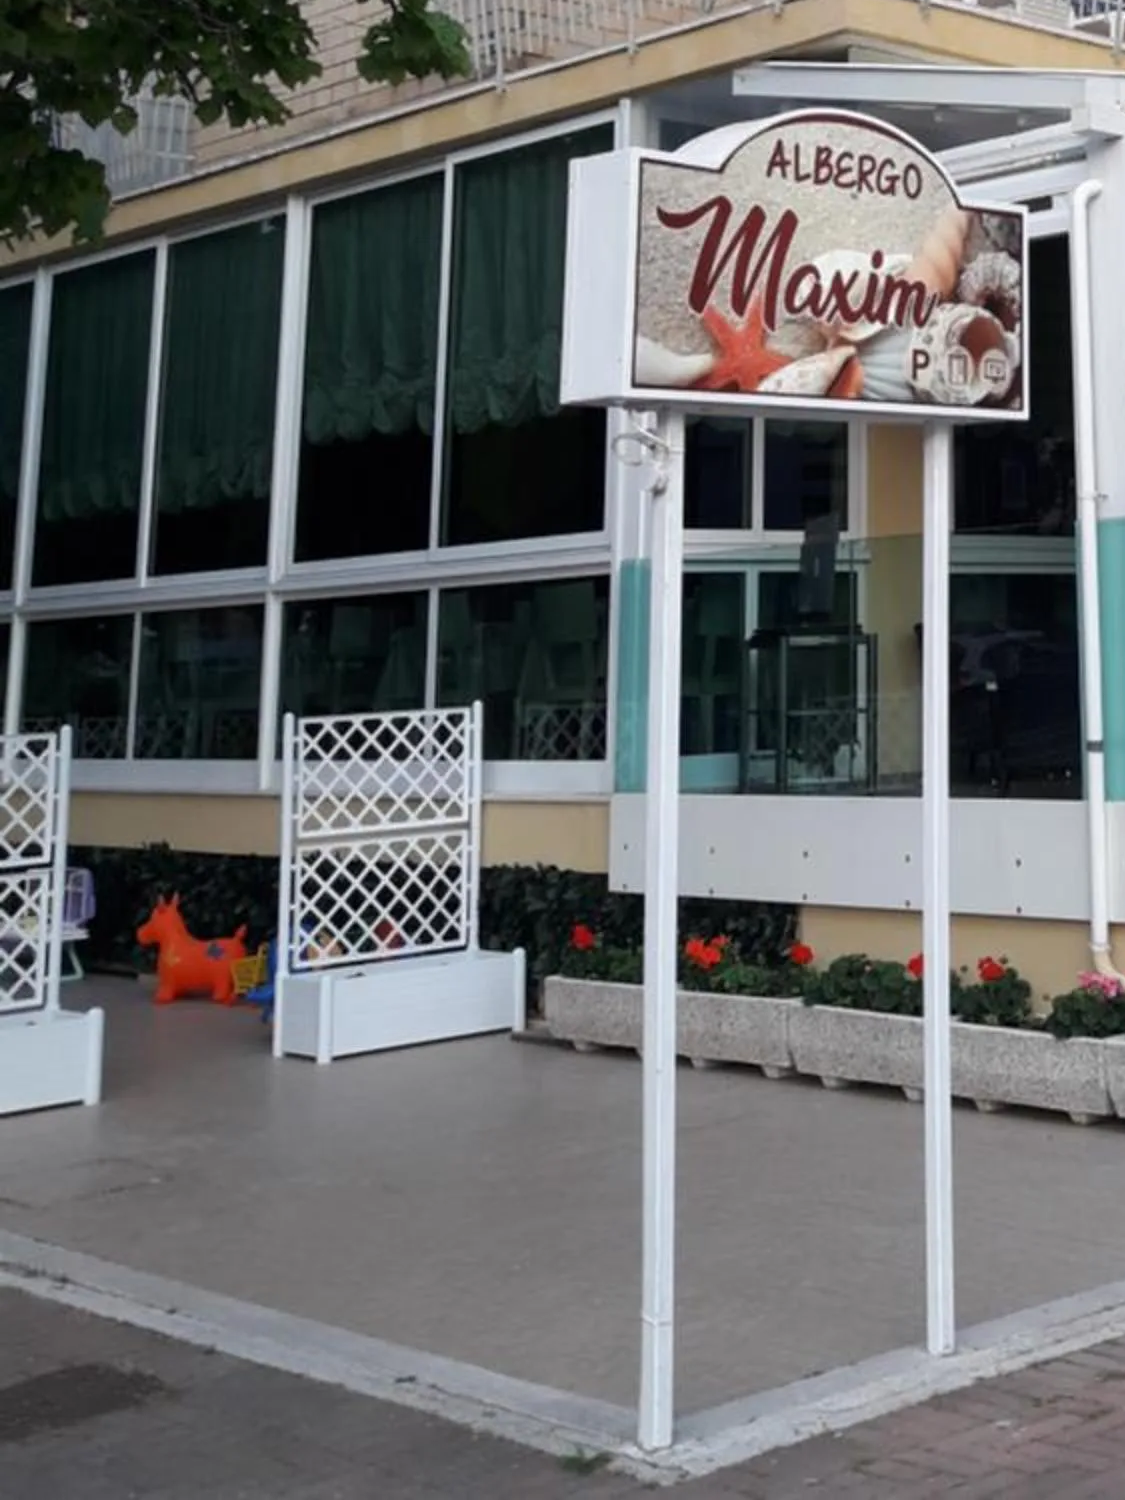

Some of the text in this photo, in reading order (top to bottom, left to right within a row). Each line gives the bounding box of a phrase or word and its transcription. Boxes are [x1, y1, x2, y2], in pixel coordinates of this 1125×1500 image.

[766, 138, 922, 200] ALBERGO
[656, 196, 937, 331] Maxim
[912, 349, 930, 380] P
